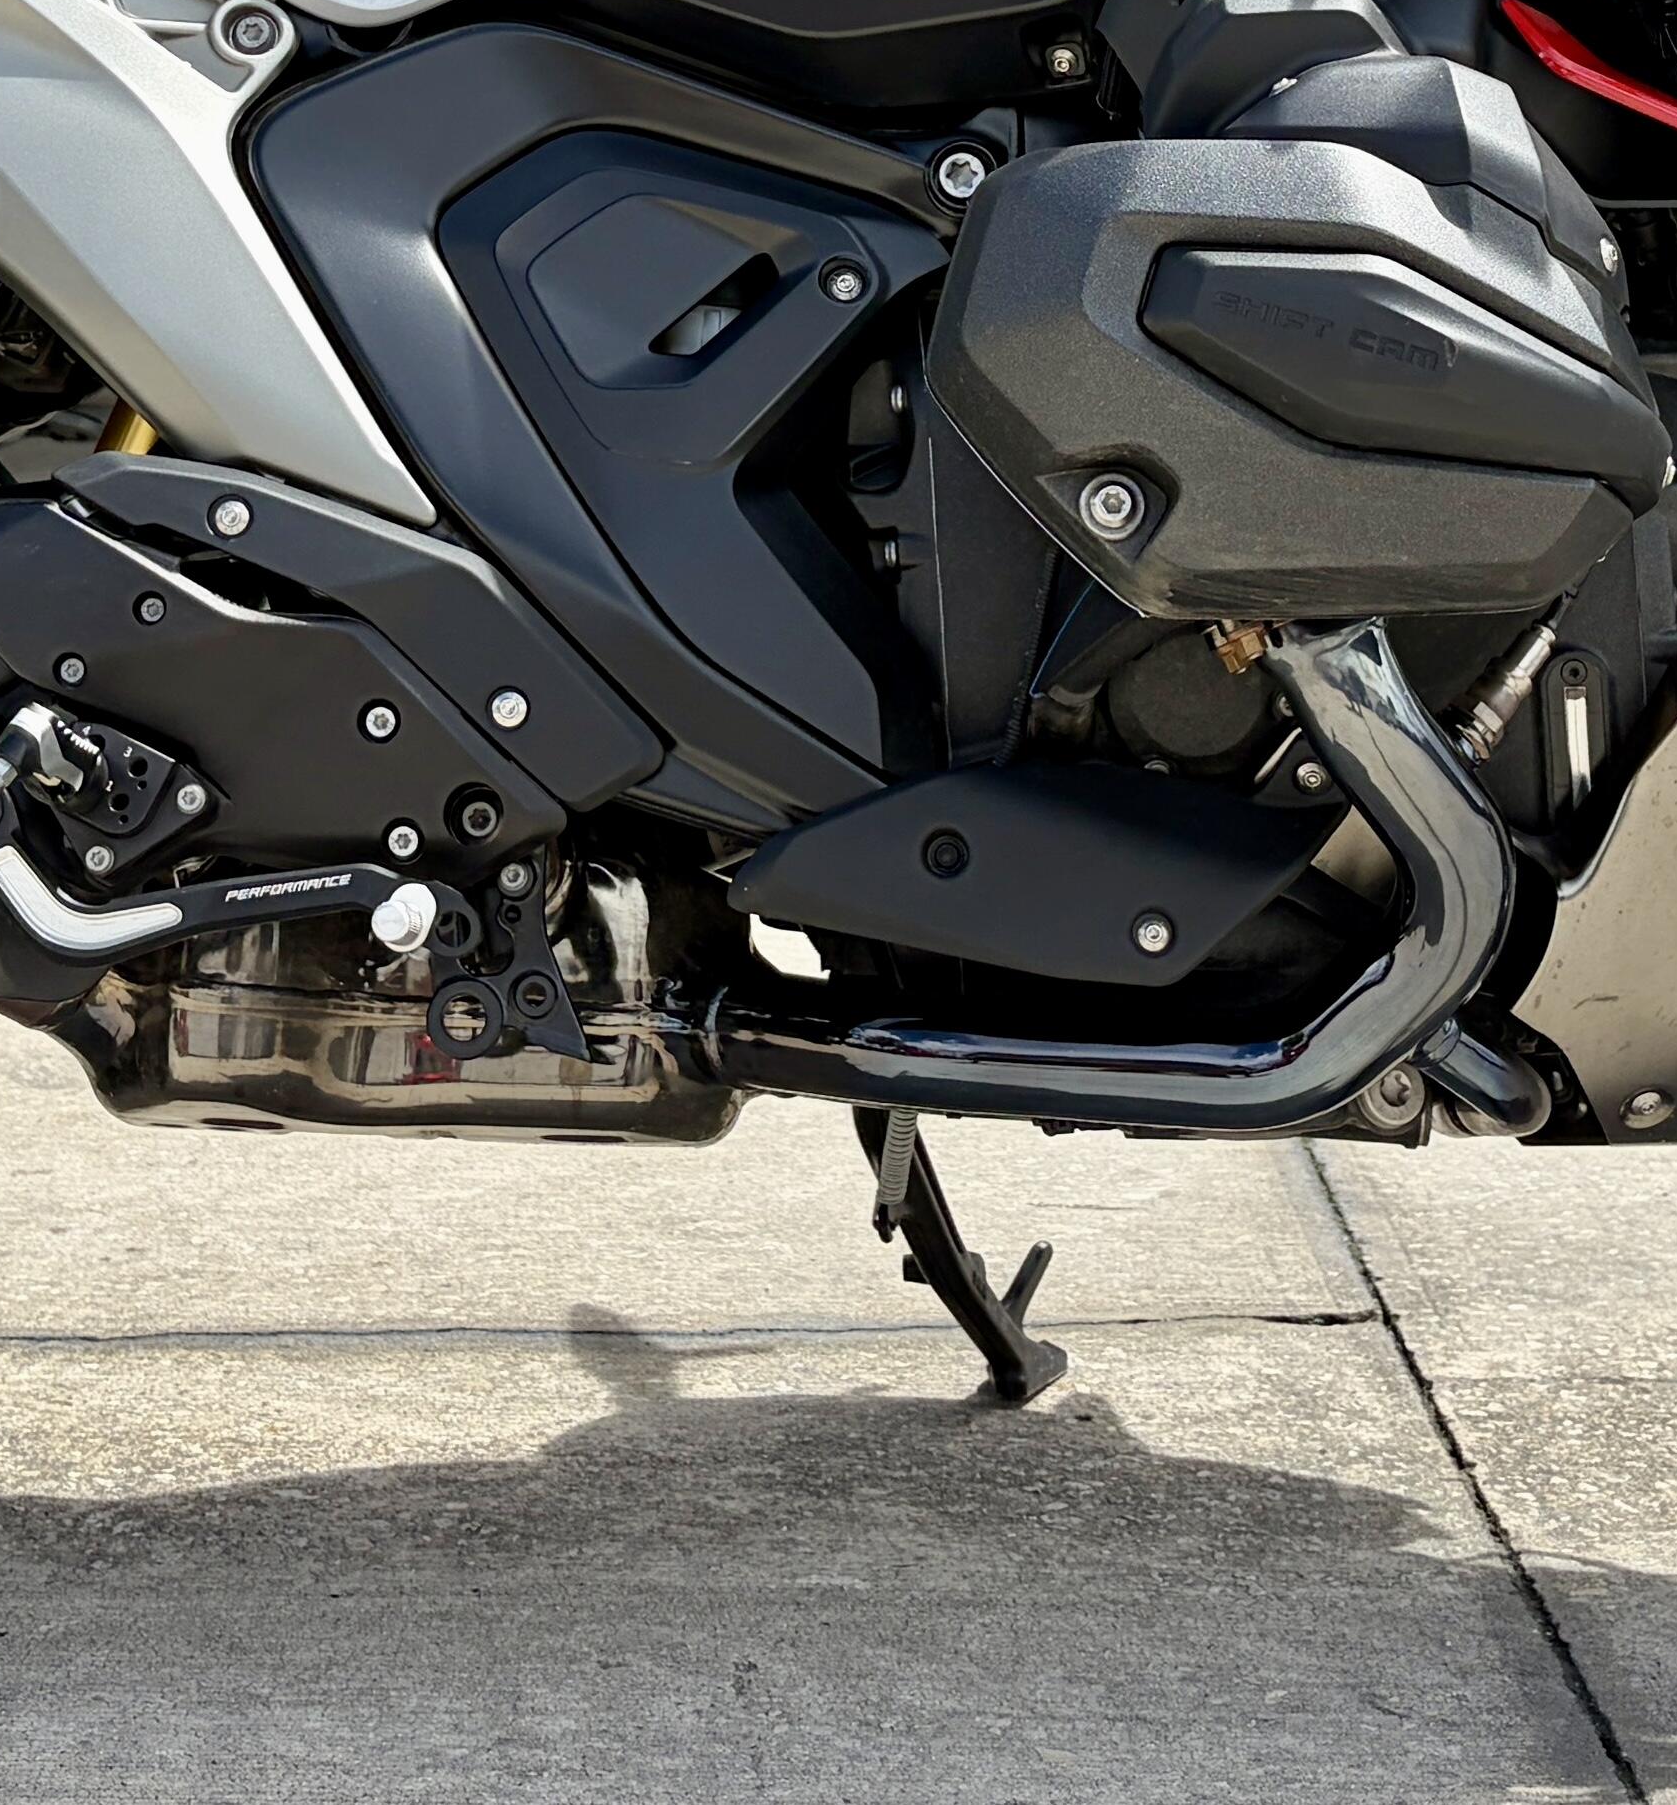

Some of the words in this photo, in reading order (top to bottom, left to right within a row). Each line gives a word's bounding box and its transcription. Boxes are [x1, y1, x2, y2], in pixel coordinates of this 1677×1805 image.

[1213, 291, 1334, 339] SHIFT
[1348, 326, 1440, 372] CAM
[123, 746, 133, 758] 3
[225, 873, 353, 903] PERFORMANCE
